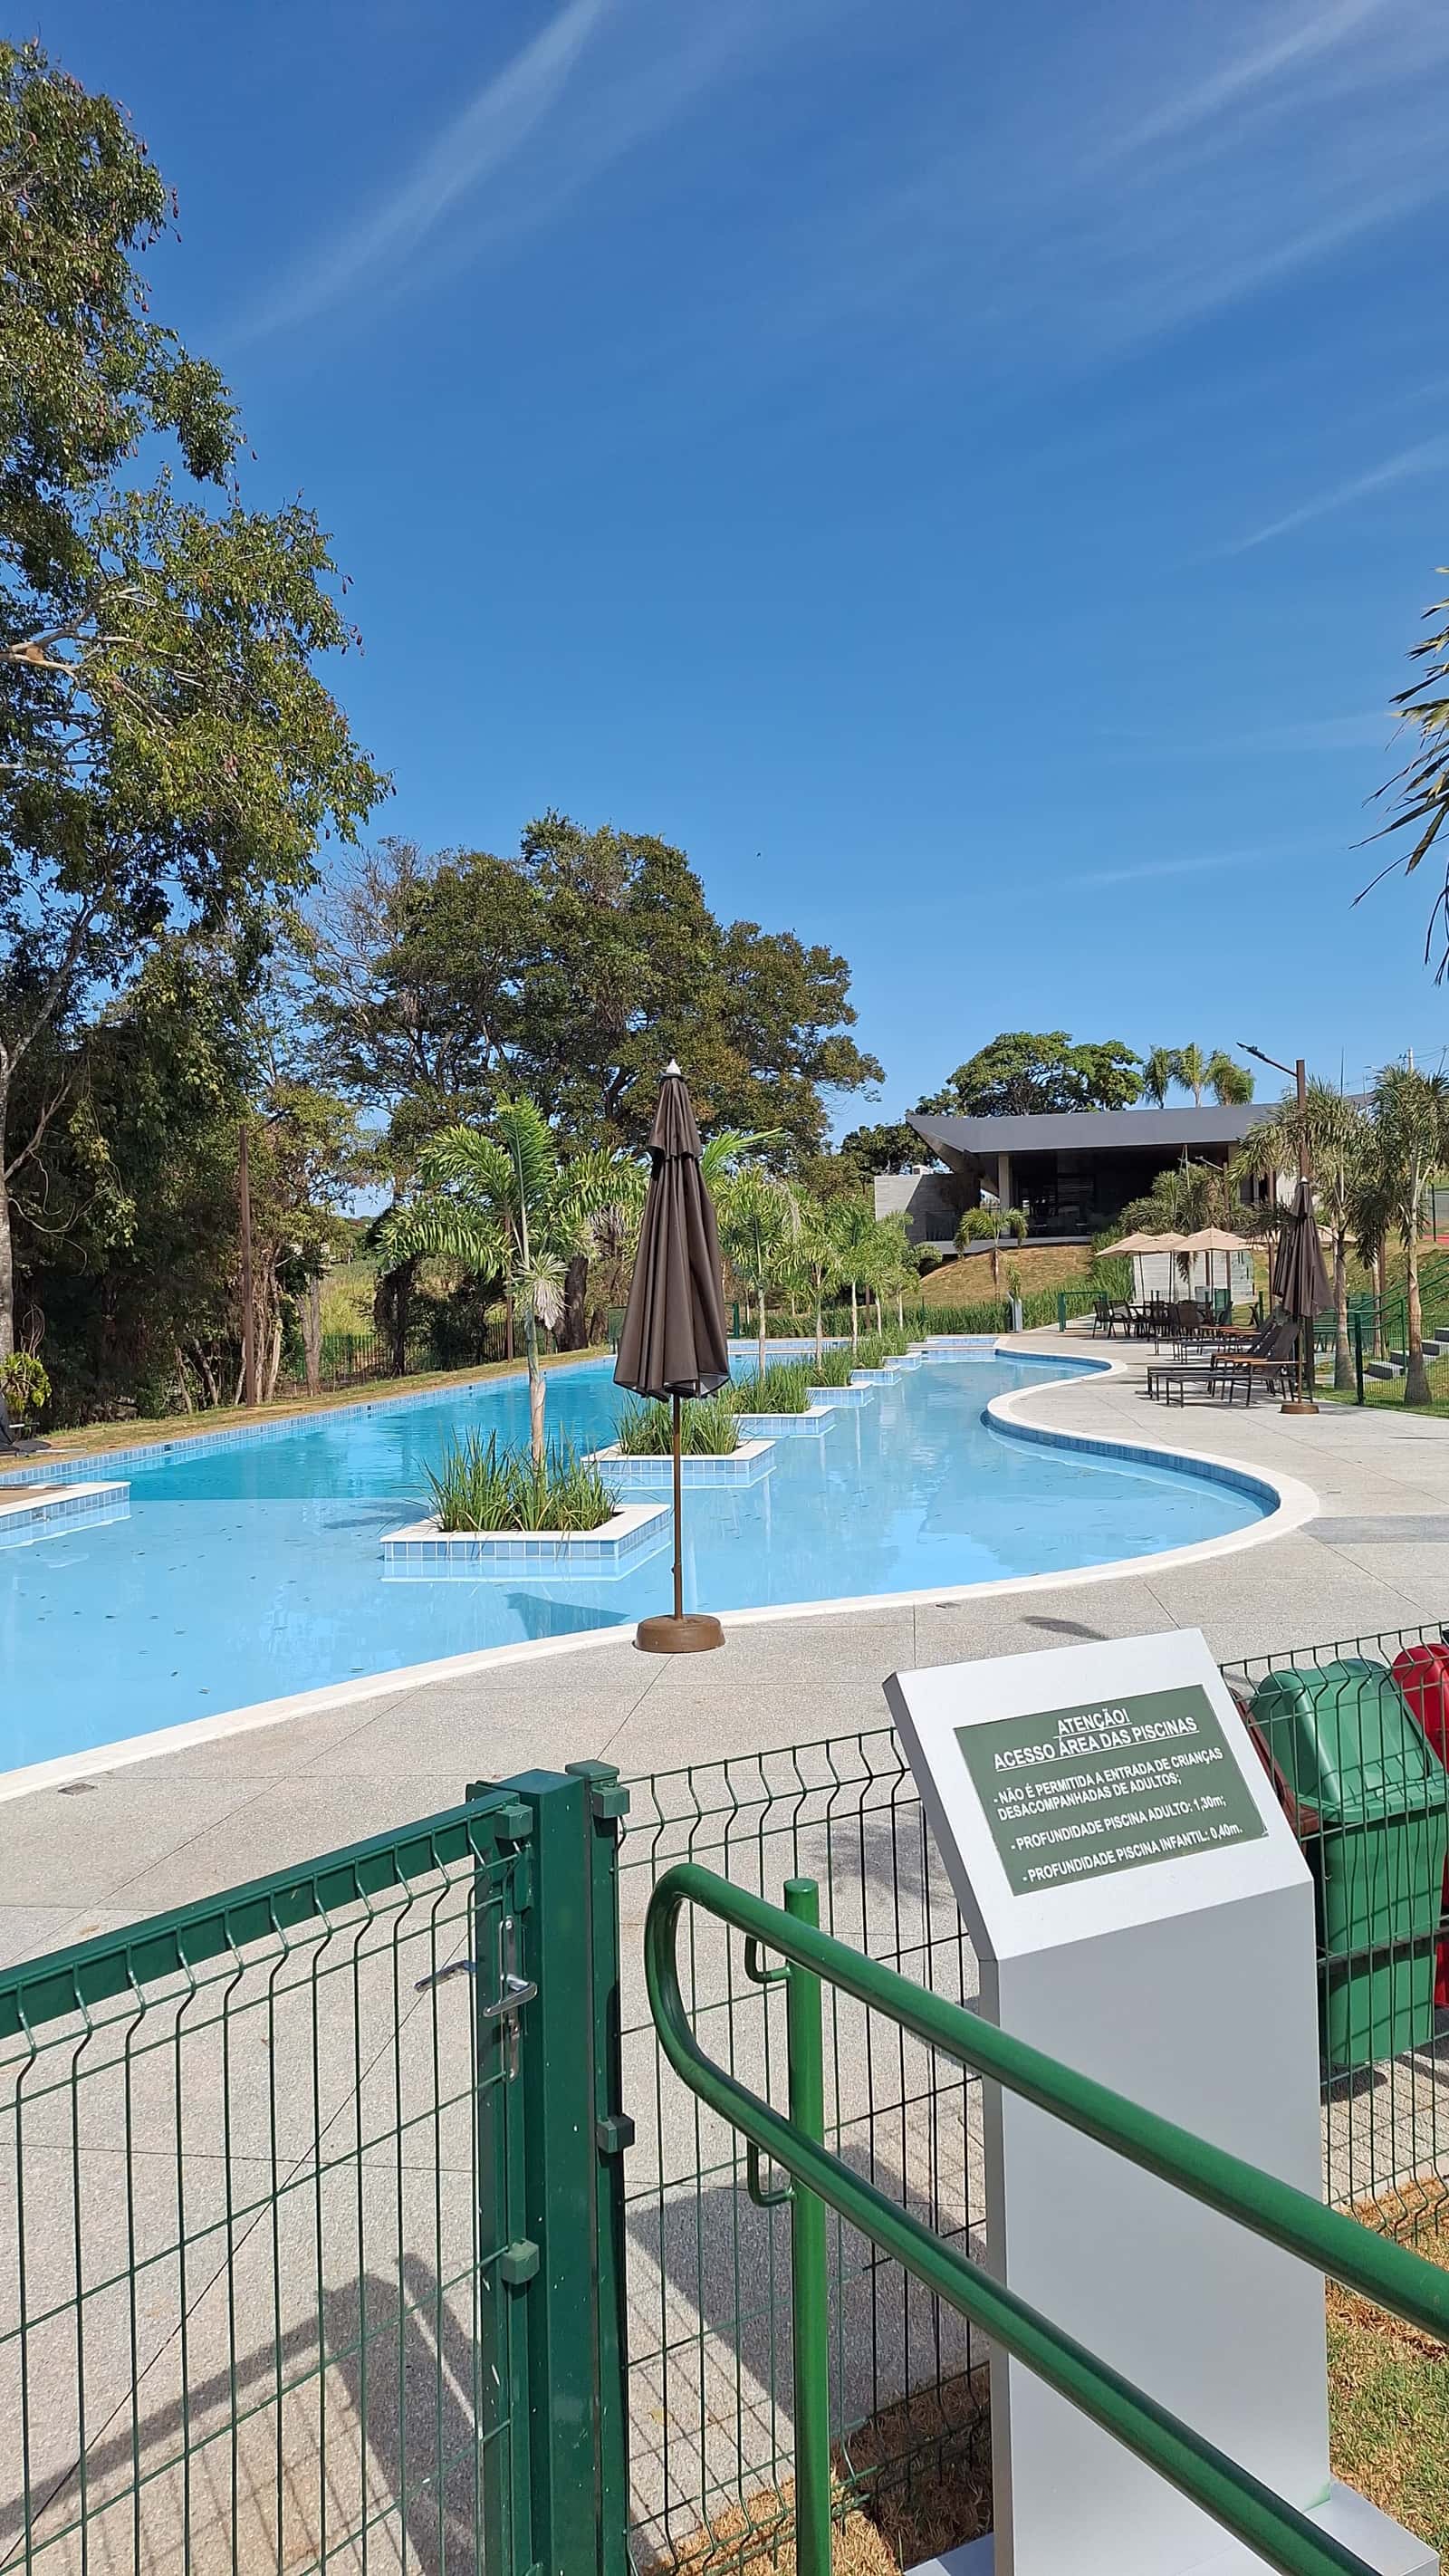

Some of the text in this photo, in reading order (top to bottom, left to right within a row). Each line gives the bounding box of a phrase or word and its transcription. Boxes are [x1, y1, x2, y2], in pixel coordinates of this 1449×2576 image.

[994, 1717, 1197, 1770] ACESSO ÁREA DAS PISCINAS
[1025, 1783, 1034, 1797] É
[1036, 1774, 1095, 1793] PERMITIDA
[1095, 1773, 1104, 1783] A
[1104, 1762, 1155, 1782] ENTRADA
[1156, 1758, 1171, 1771] DE
[1172, 1748, 1223, 1768] CRIANÇAS
[997, 1773, 1182, 1821] DESACOMPANHADAS DE ADULTOS;
[1105, 1813, 1148, 1831] PISCINA
[1148, 1803, 1193, 1819] ADULTO:
[1194, 1796, 1226, 1812] 1,30m;
[1116, 1844, 1159, 1860] PISCINA
[1159, 1831, 1209, 1852] INFANTIL:
[1210, 1824, 1243, 1840] 0,40m.
